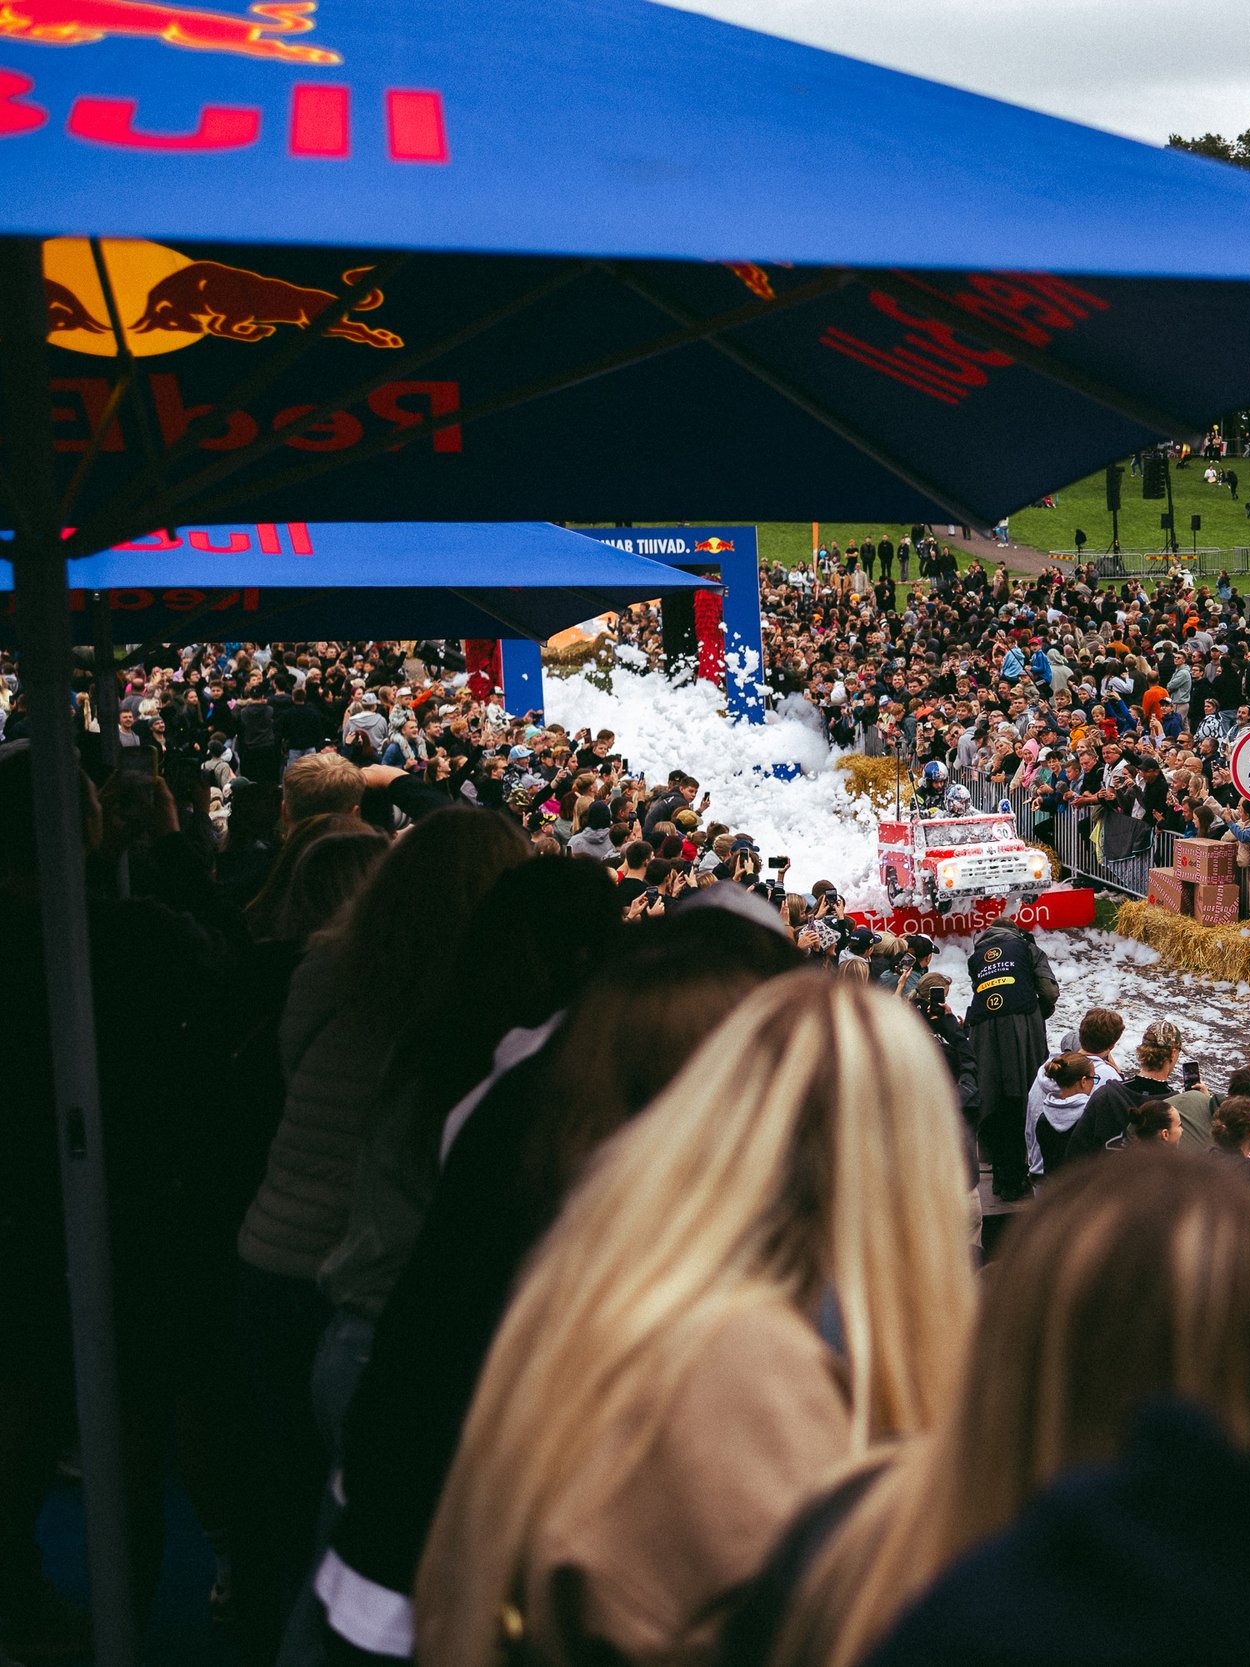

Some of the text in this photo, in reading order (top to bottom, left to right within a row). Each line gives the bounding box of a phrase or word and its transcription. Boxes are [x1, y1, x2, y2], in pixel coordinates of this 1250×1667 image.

[0, 68, 449, 165] ull
[636, 538, 691, 554] TIIIVAD.
[903, 917, 935, 934] on
[990, 997, 1000, 1007] 12
